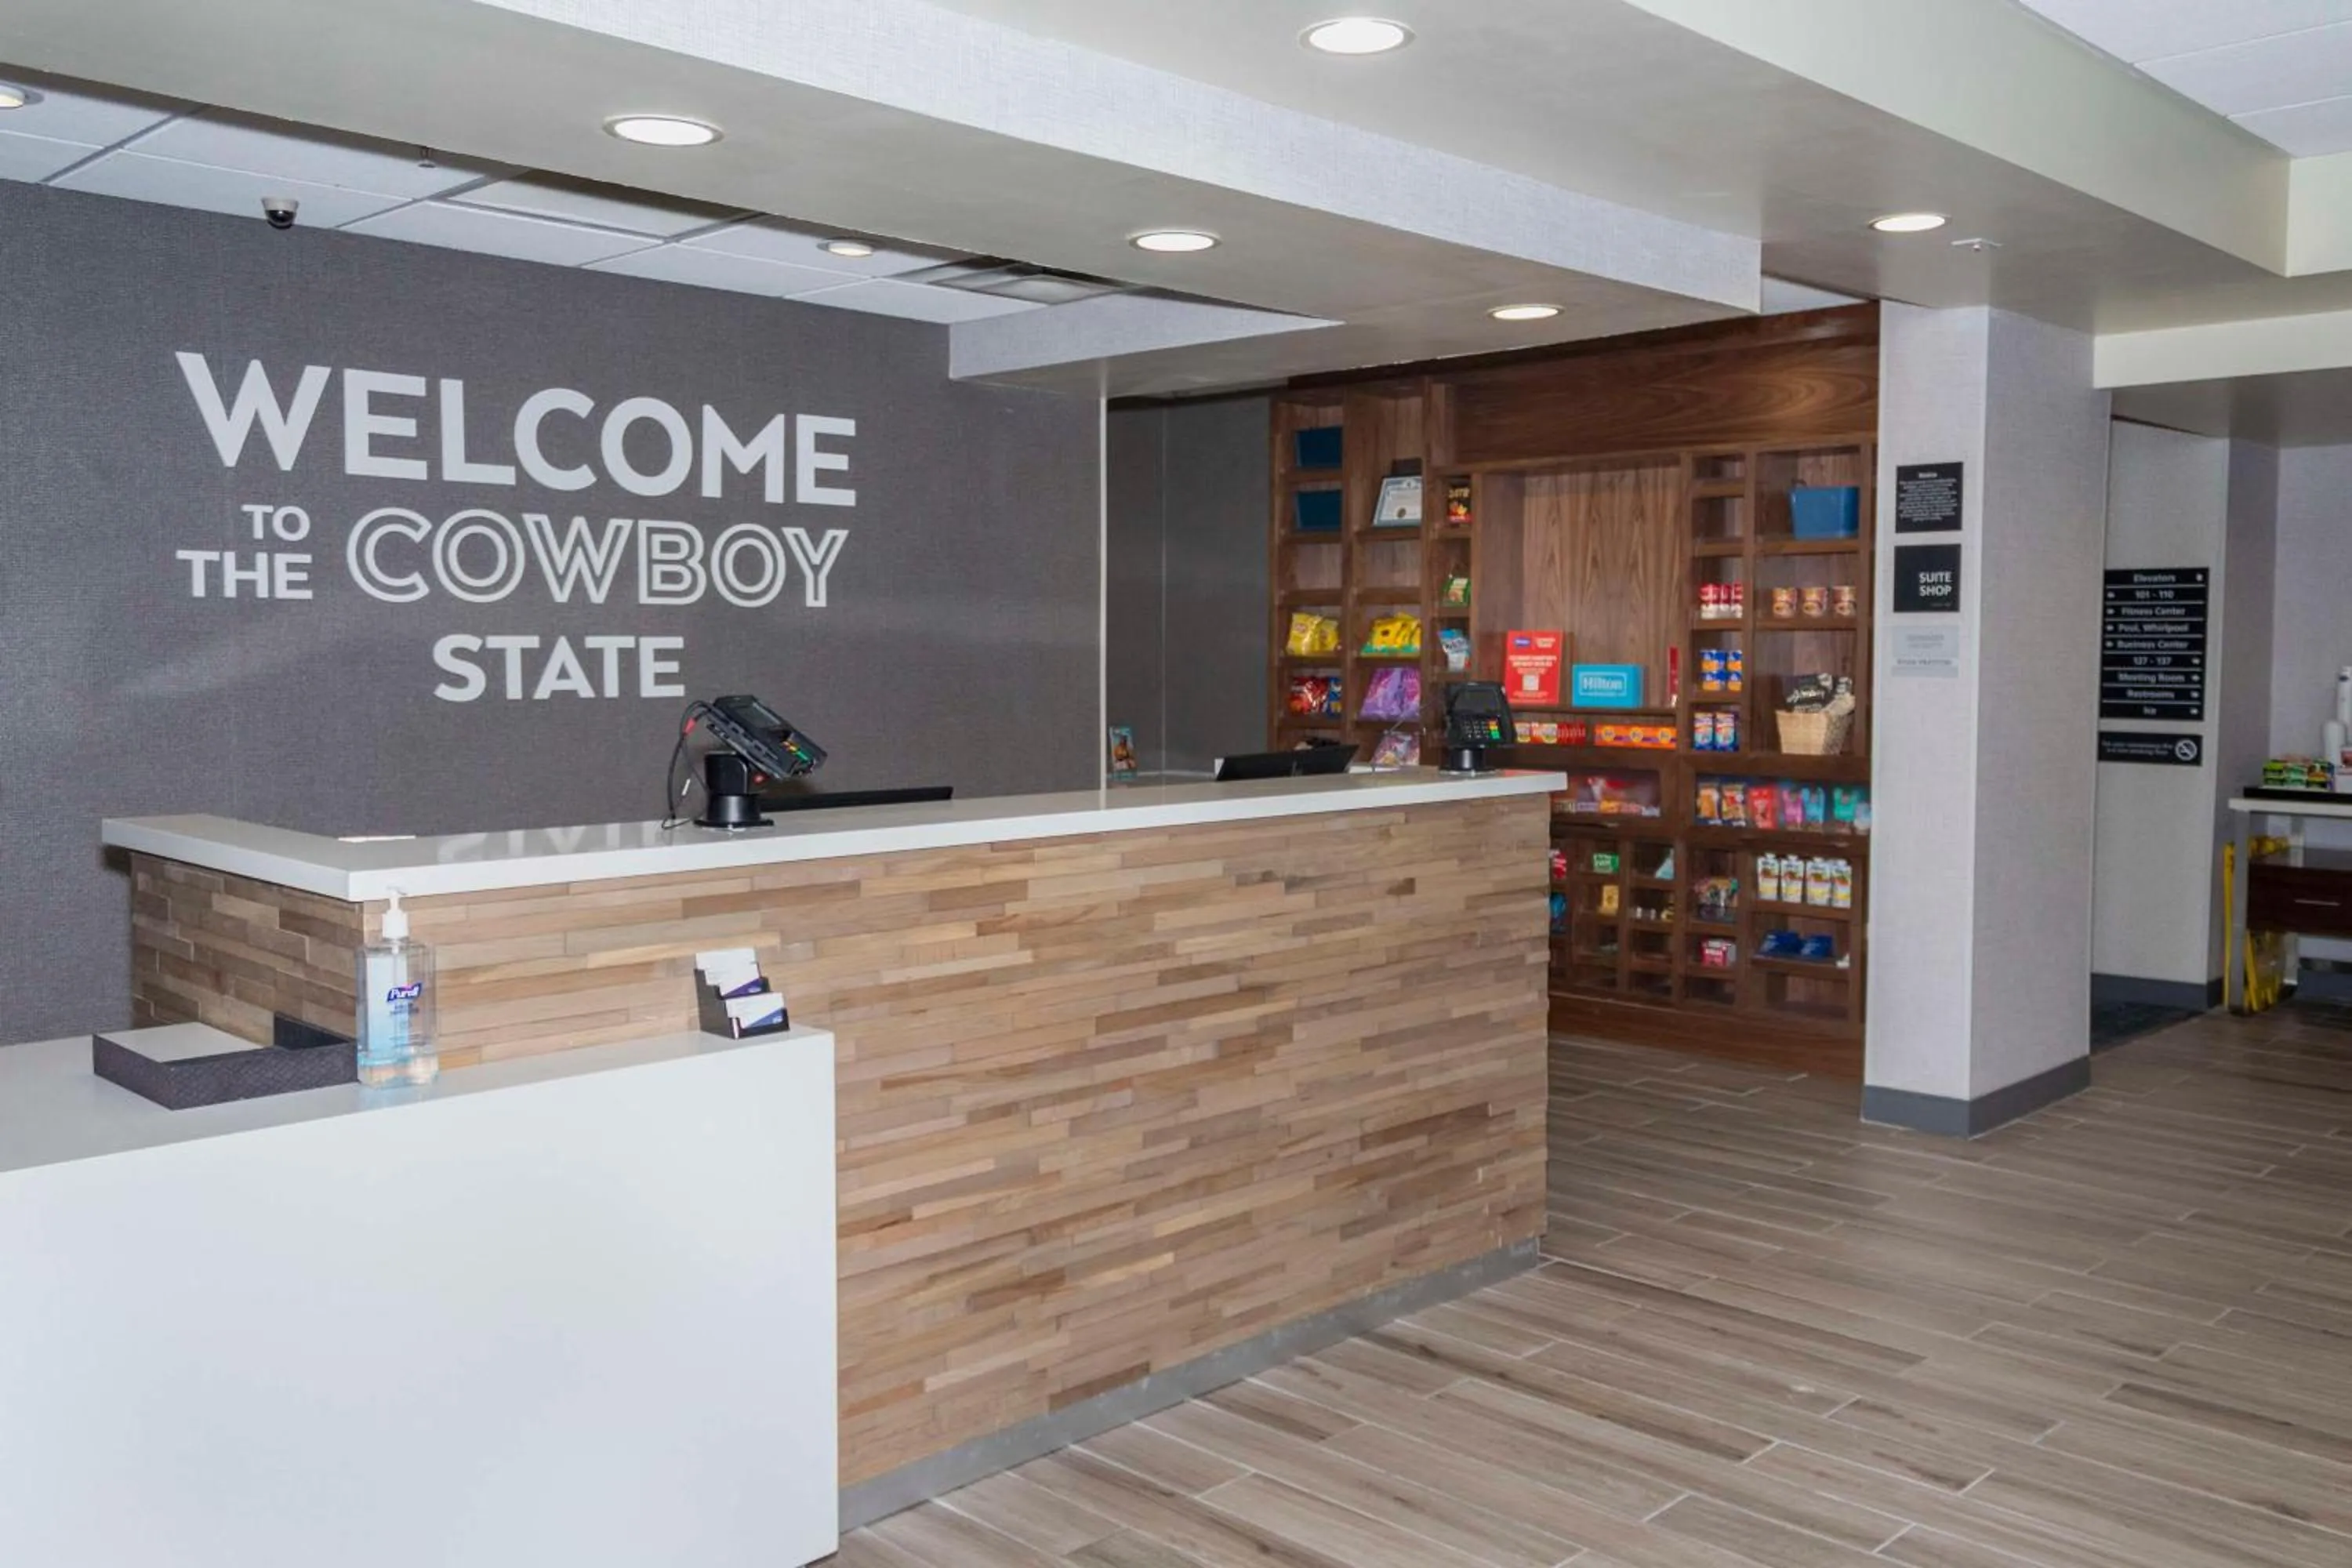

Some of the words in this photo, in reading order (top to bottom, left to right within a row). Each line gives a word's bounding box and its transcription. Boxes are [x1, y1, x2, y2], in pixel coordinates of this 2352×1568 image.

[175, 351, 857, 507] WELCOME
[241, 504, 310, 543] TO
[347, 506, 849, 608] COWBOY
[176, 550, 313, 601] THE
[1918, 572, 1952, 583] SUITE
[2133, 574, 2176, 583] Elevators
[1918, 585, 1952, 597] SHOP
[2154, 607, 2186, 615] Center
[2143, 623, 2189, 633] Whirlpool
[2158, 641, 2188, 649] Center
[433, 634, 685, 703] STATE
[1582, 677, 1624, 690] Hilton
[2118, 673, 2157, 683] Meeting
[2158, 673, 2185, 682] Room
[2126, 689, 2175, 699] Restrooms
[390, 985, 419, 1000] Purell
